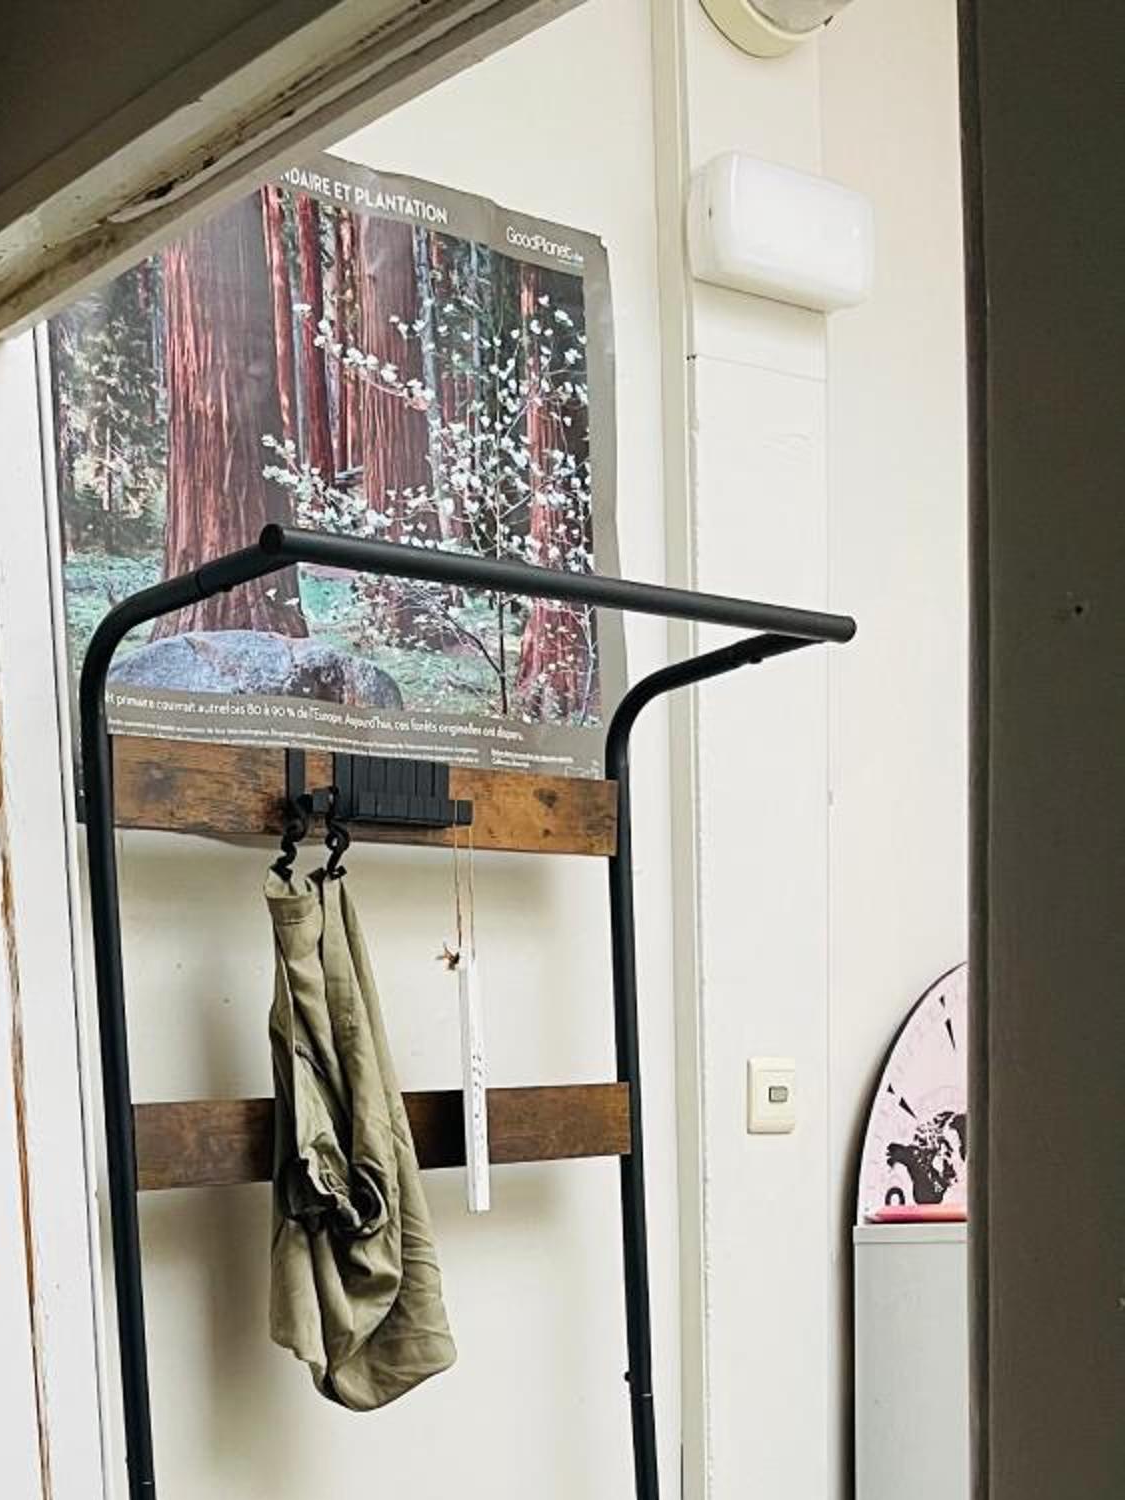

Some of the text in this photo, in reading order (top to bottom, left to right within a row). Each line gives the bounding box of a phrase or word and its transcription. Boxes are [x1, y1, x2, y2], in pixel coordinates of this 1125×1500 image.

[334, 182, 352, 202] ET
[354, 187, 449, 225] PLANTATION
[198, 701, 245, 716] autrefois
